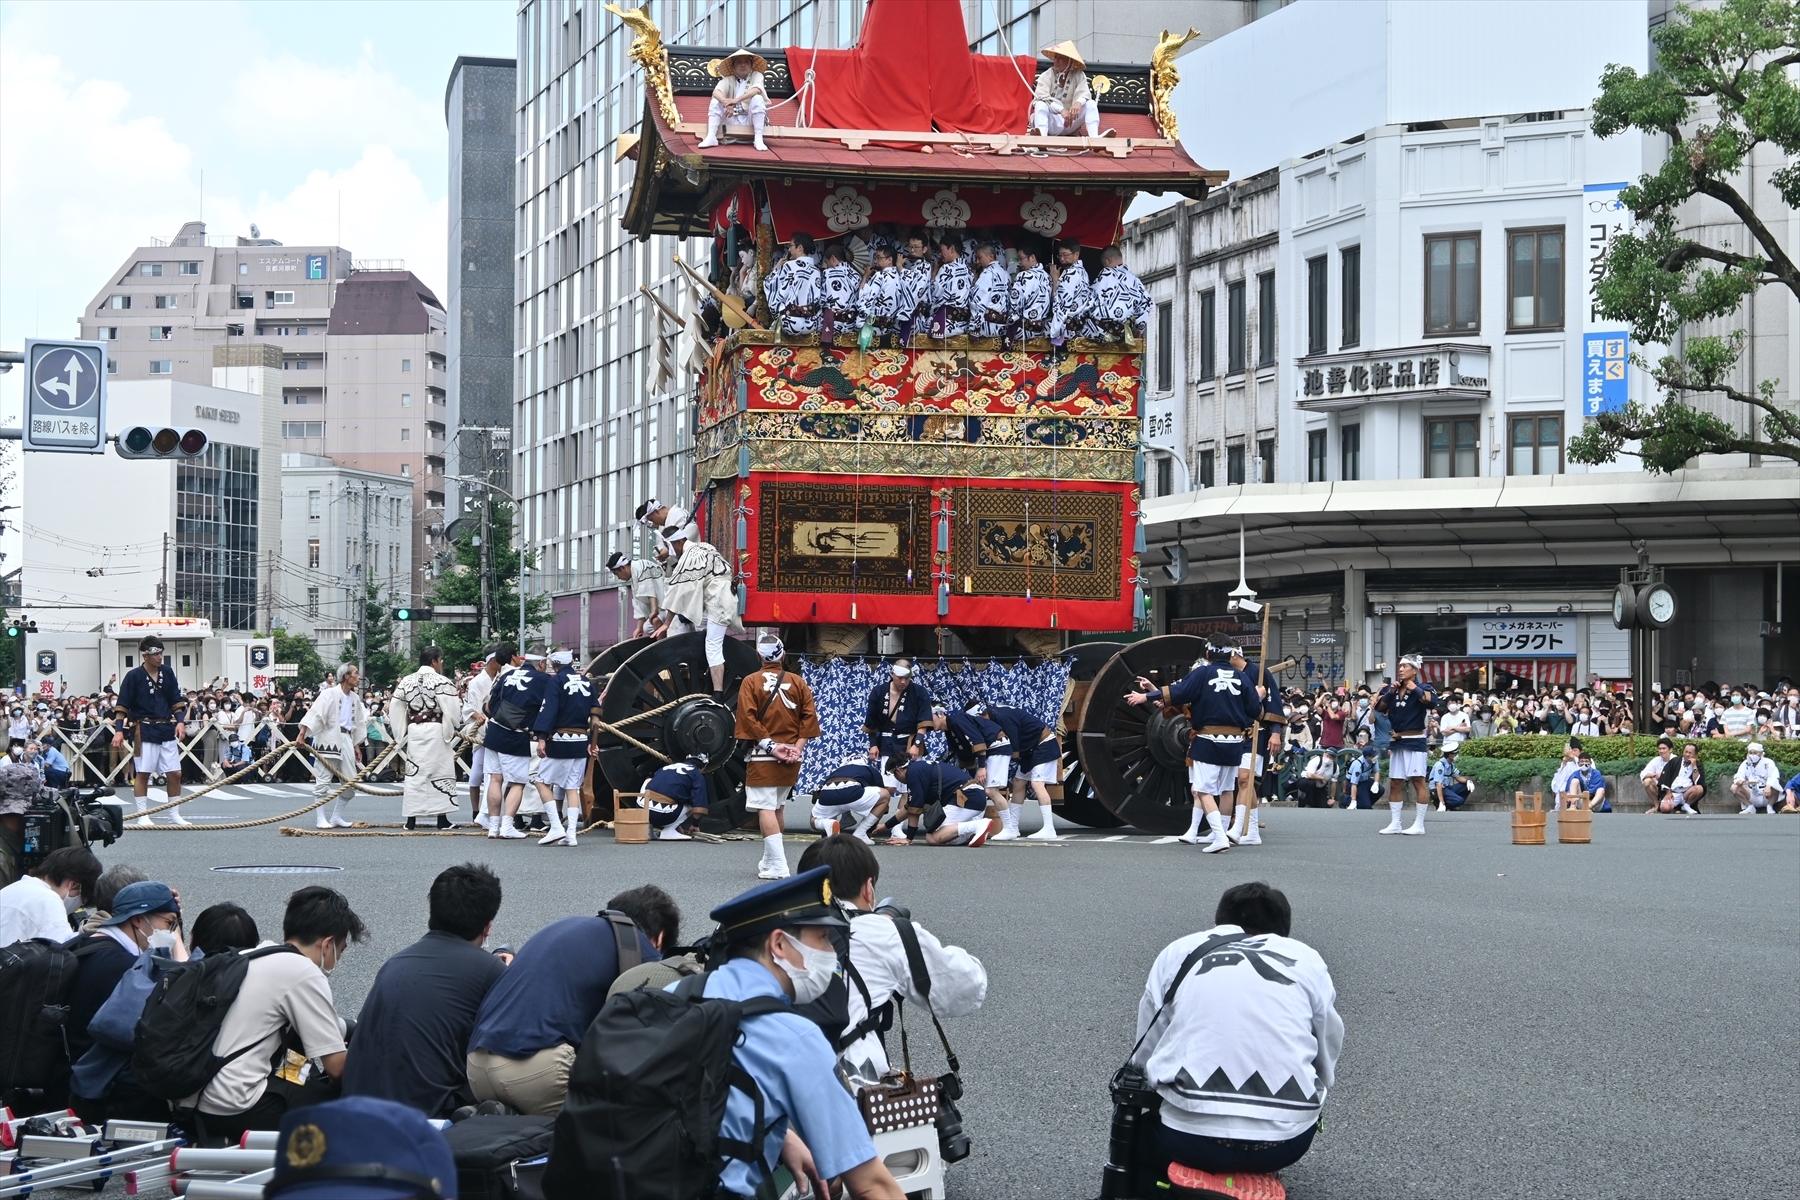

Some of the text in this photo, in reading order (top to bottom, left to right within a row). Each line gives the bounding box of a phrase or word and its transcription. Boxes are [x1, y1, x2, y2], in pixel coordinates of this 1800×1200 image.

[259, 257, 302, 265] エステムコート
[265, 265, 297, 273] 京都河原町
[1607, 341, 1622, 378] すぐ
[1303, 357, 1440, 396] 池善化粧品店
[1587, 340, 1604, 413] 買えます
[219, 408, 241, 424] SEED
[32, 419, 96, 436] 路線バスを除く
[1508, 621, 1564, 631] メガネスーパー
[1482, 633, 1564, 651] コンタクト
[253, 674, 267, 688] 救
